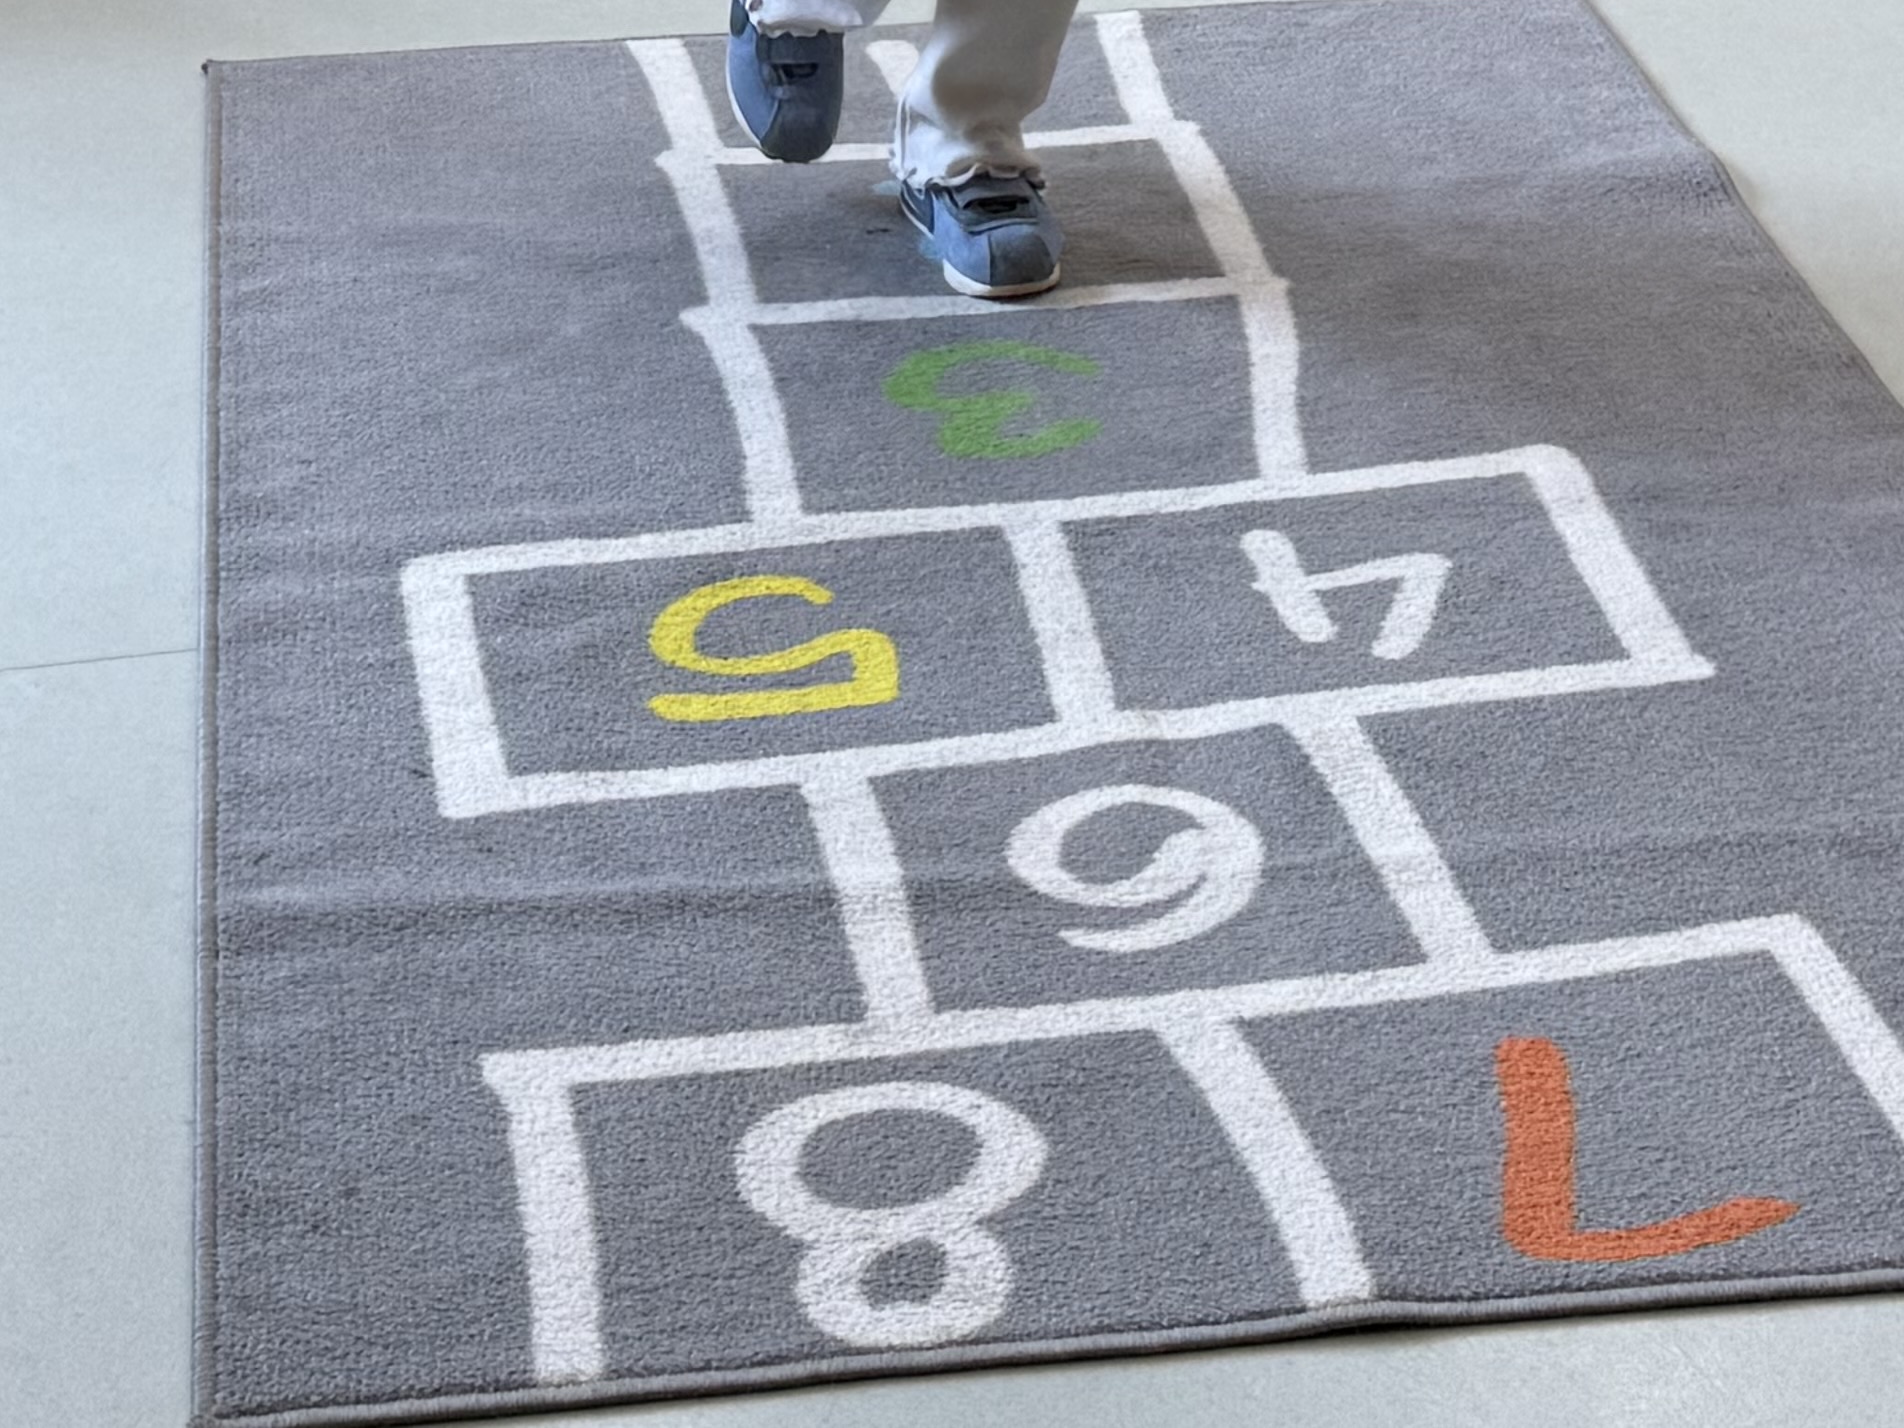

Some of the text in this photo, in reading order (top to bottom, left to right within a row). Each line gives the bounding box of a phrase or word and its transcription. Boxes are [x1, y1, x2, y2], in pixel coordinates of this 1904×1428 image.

[883, 339, 1102, 460] 3
[646, 574, 901, 723] 5
[1238, 528, 1454, 660] 4
[1004, 782, 1268, 955] 6
[734, 1078, 1051, 1348] 8
[1496, 1037, 1798, 1262] 7
